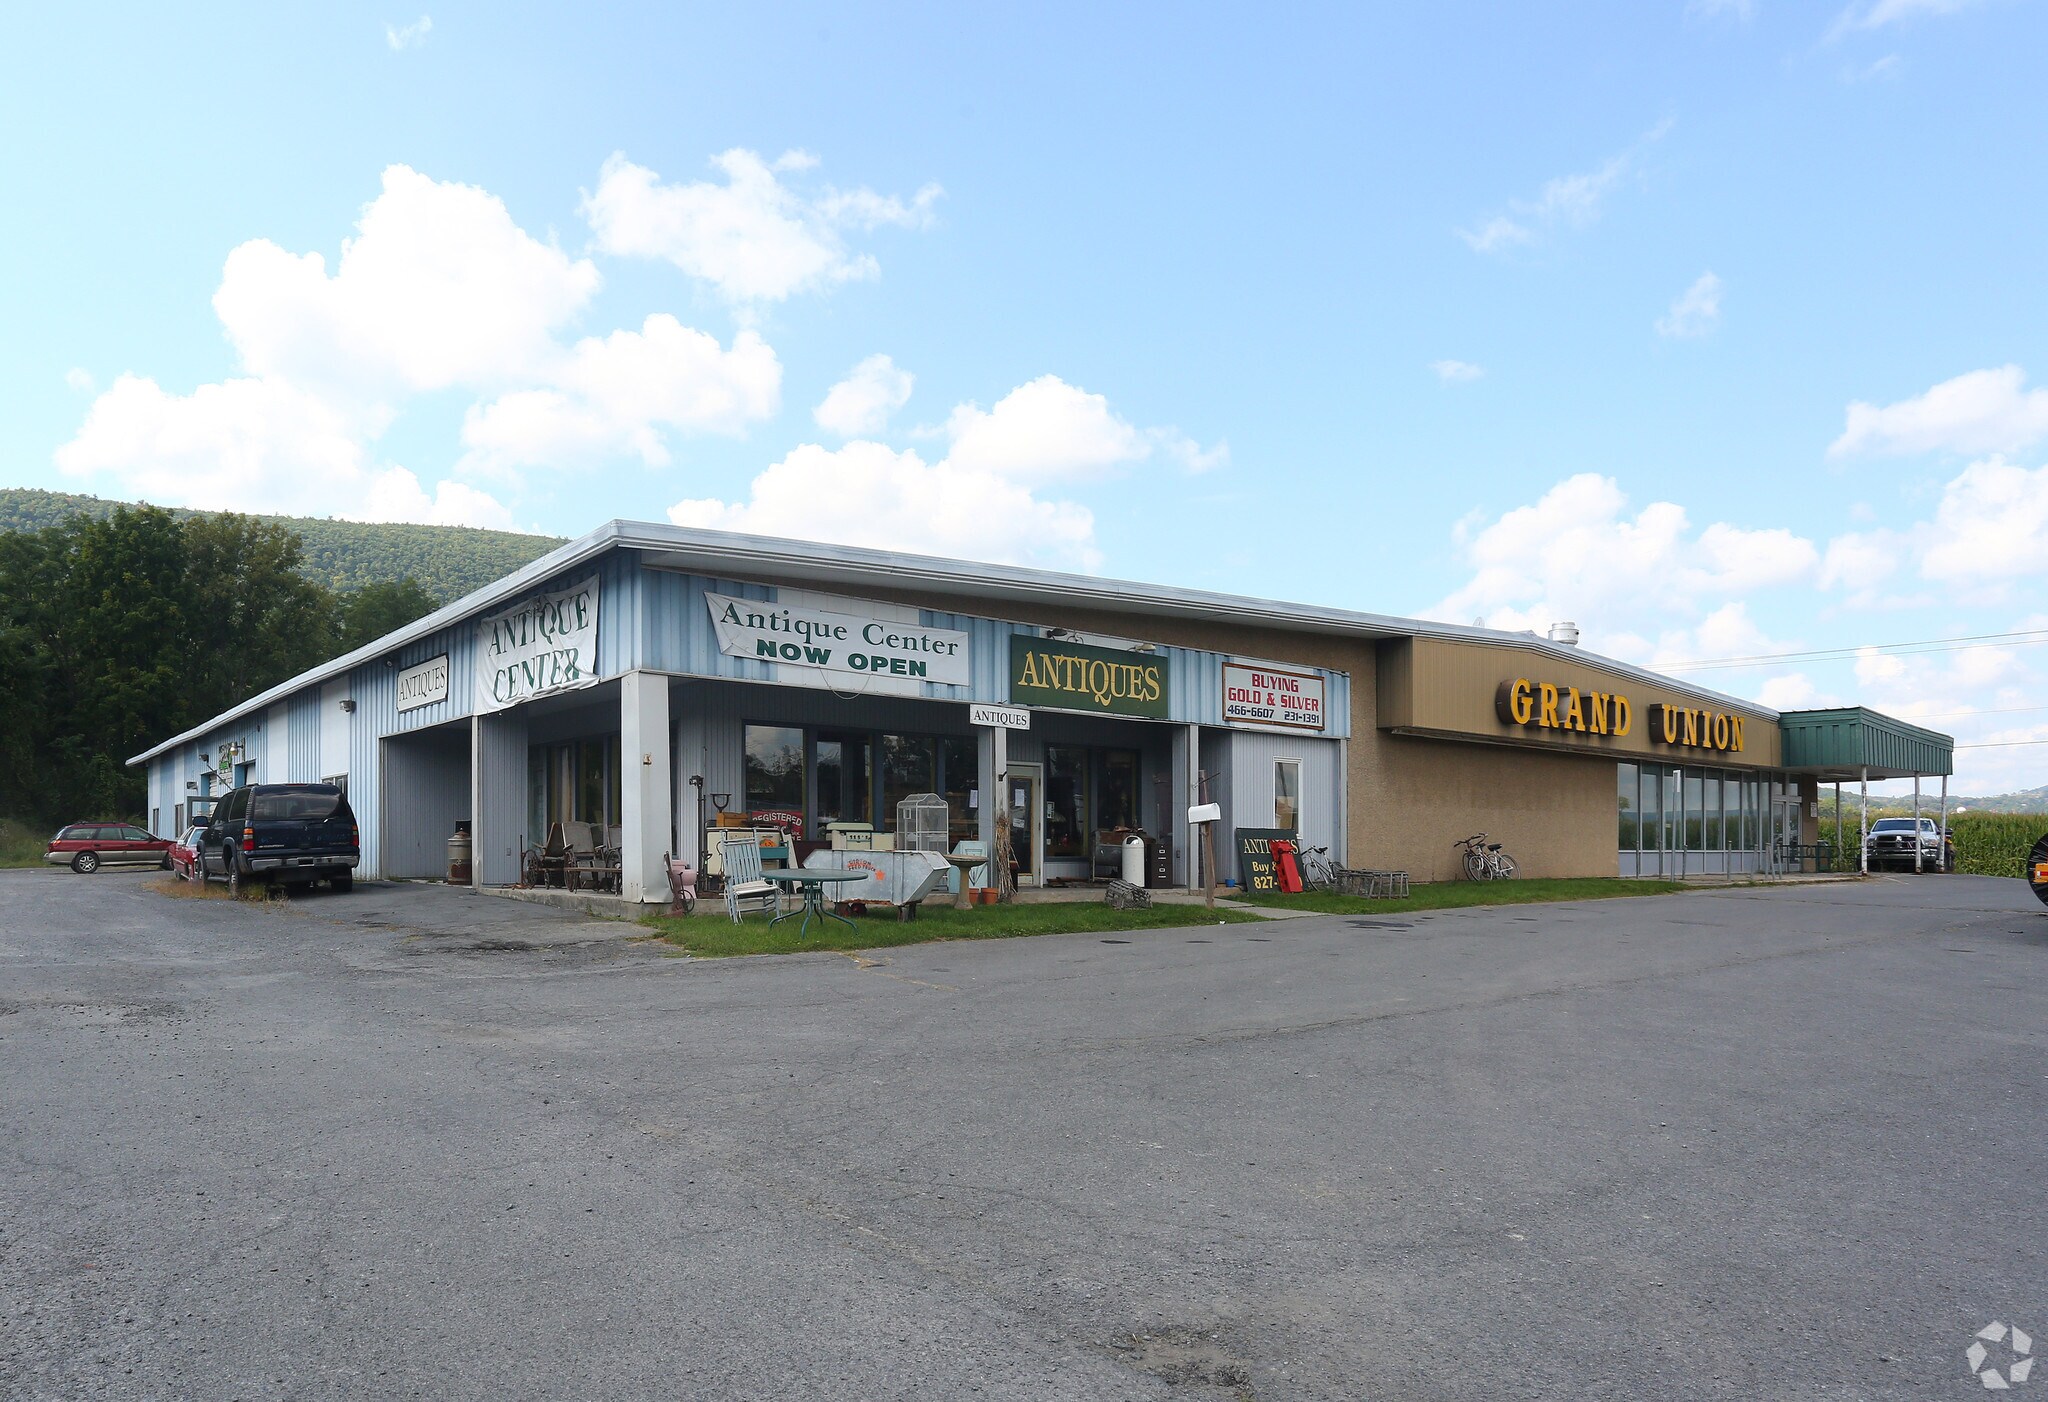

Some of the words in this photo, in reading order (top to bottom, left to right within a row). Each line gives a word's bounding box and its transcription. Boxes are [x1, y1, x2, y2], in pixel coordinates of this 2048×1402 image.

[488, 589, 591, 657] ANTIQUE
[720, 601, 848, 644] Antique
[862, 623, 959, 656] Center
[492, 647, 580, 703] CENTER
[756, 638, 832, 665] NOW
[847, 652, 927, 678] OPEN
[398, 665, 446, 702] ANTIQUES
[1017, 650, 1161, 707] ANTIQUES
[1251, 673, 1299, 693] BUYING
[1227, 704, 1275, 719] 466-6607
[1284, 711, 1320, 724] 231-1391
[1228, 687, 1262, 704] GOLD
[1266, 692, 1276, 706] &
[1280, 694, 1319, 711] SILVER
[1509, 677, 1632, 737] GRAND
[1661, 703, 1745, 752] UNION
[973, 710, 1027, 726] ANTIQUES
[1243, 838, 1299, 855] ANTIS
[1252, 861, 1270, 874] Buy
